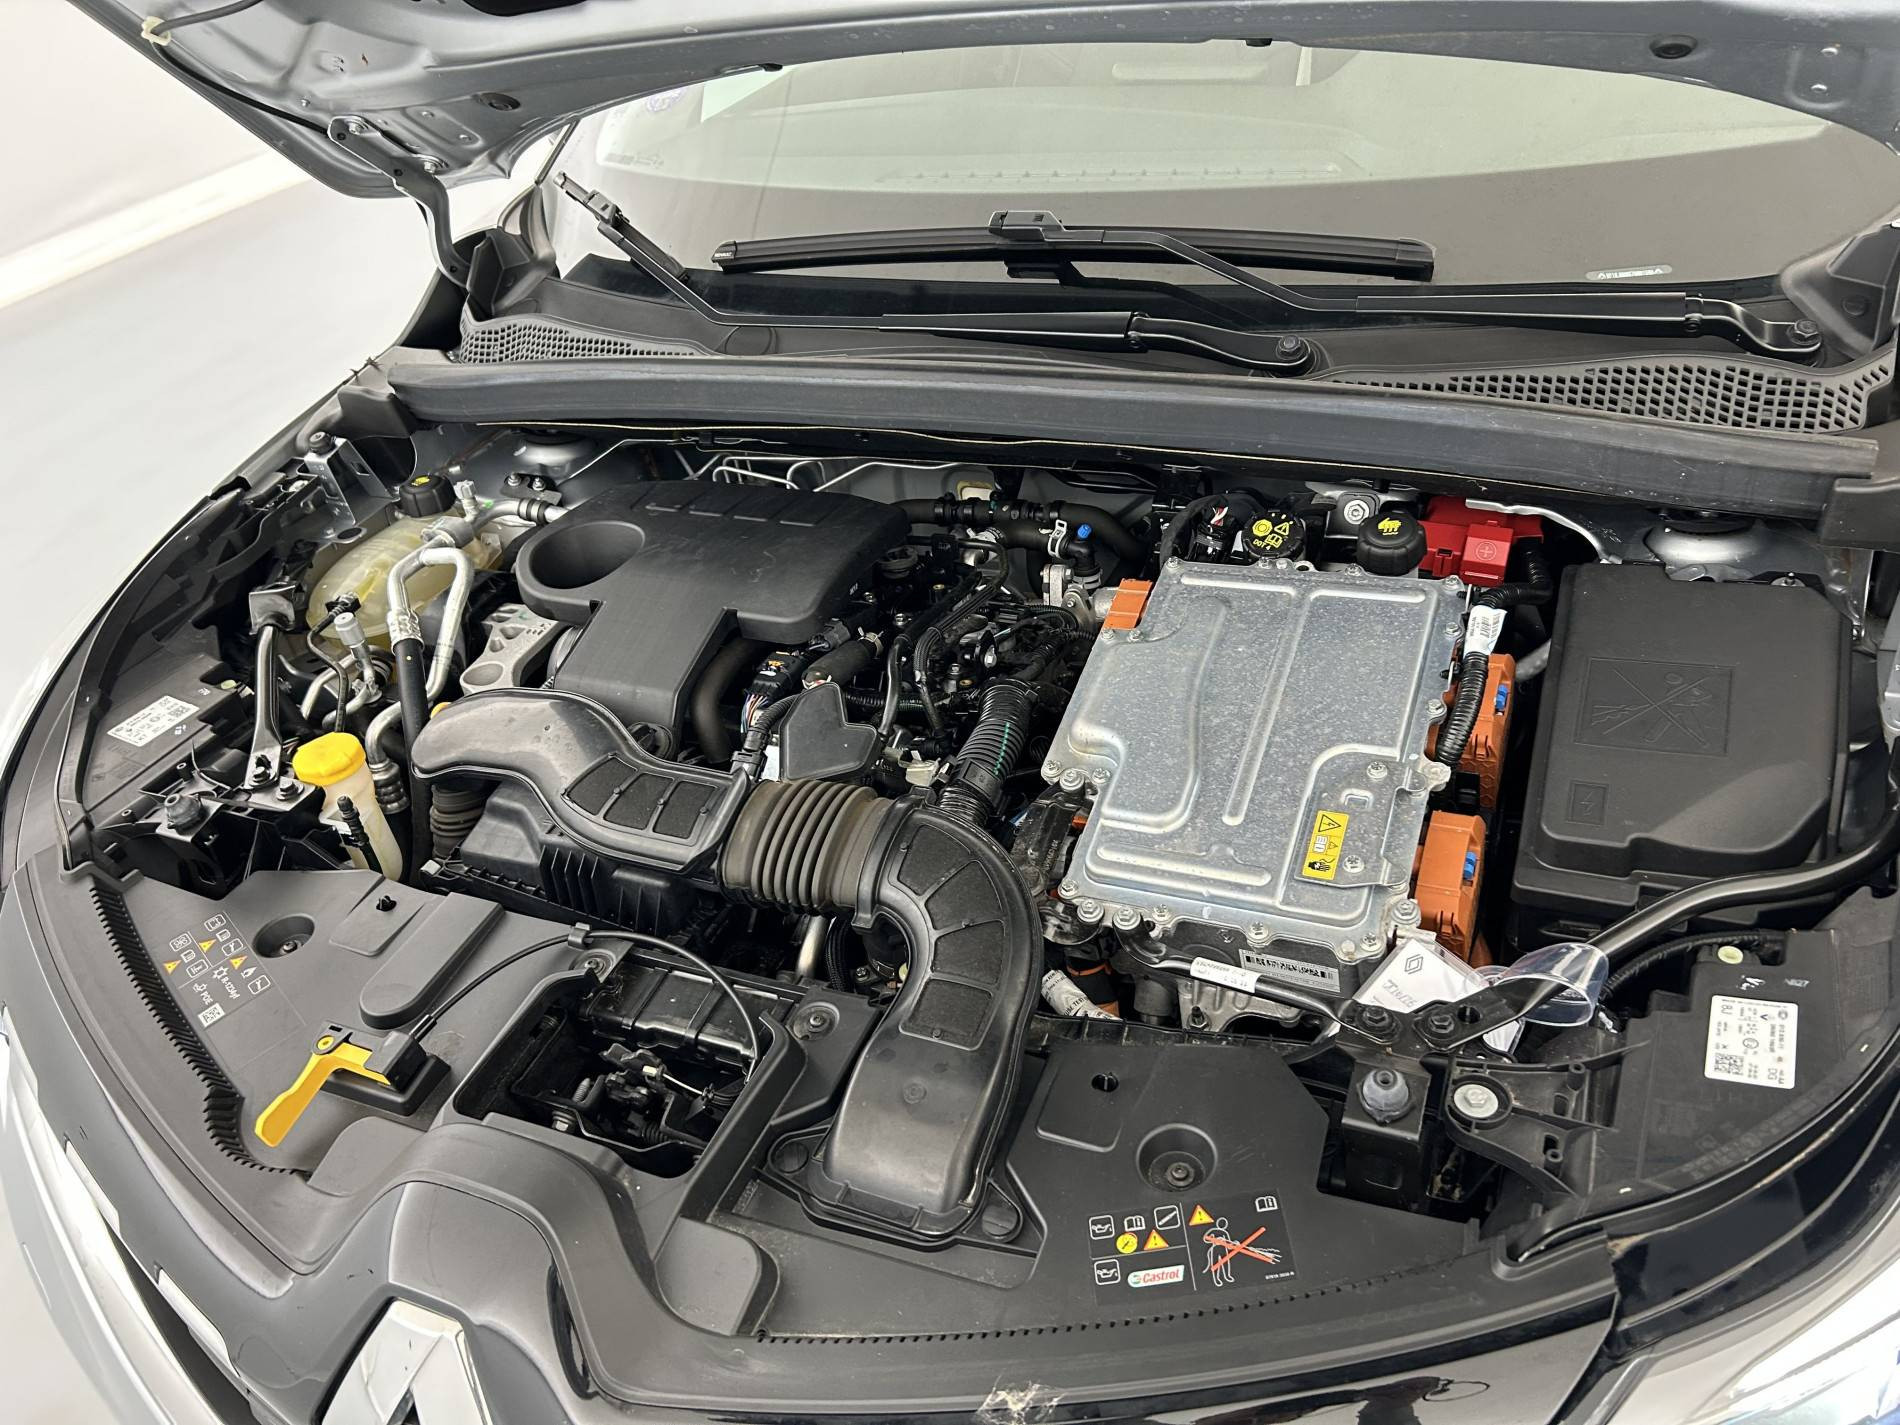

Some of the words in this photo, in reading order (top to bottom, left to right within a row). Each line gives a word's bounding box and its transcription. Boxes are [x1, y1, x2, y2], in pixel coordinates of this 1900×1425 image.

[1253, 539, 1266, 548] DOT
[200, 991, 213, 1005] POE
[1142, 1269, 1180, 1284] Castrol
